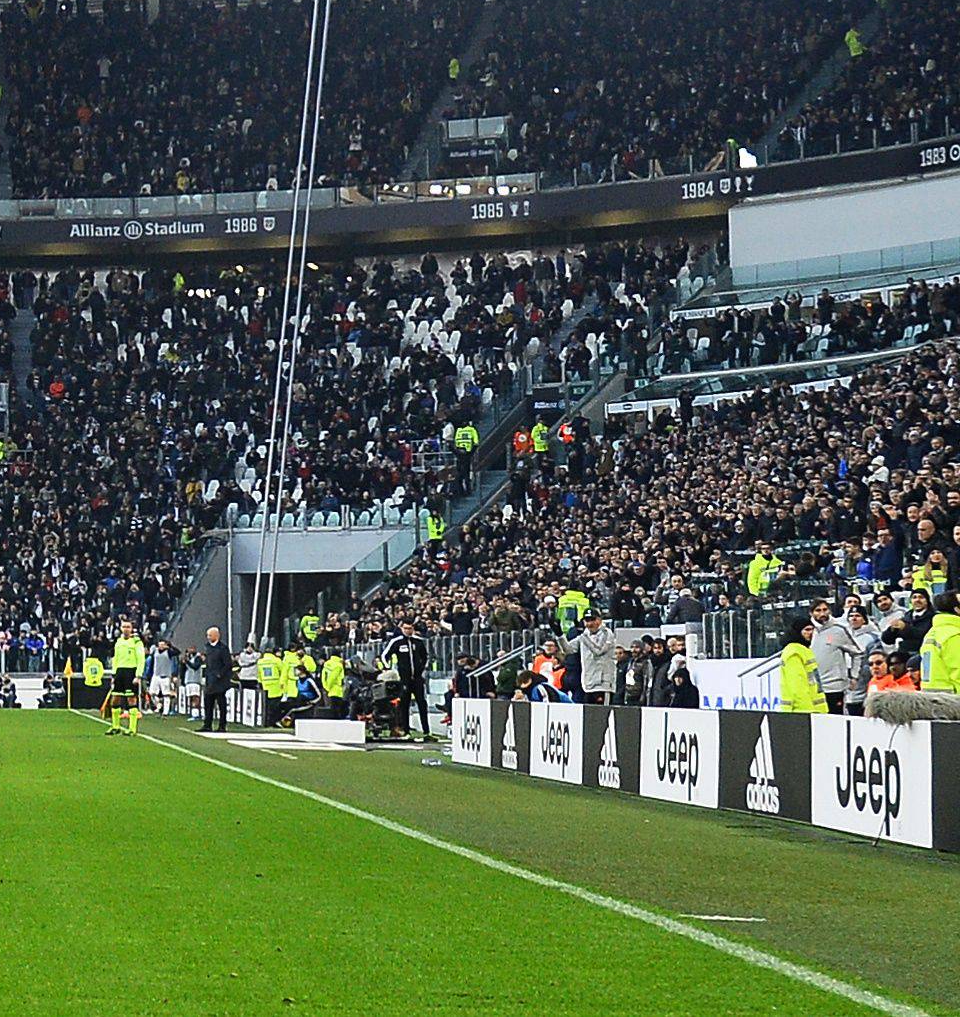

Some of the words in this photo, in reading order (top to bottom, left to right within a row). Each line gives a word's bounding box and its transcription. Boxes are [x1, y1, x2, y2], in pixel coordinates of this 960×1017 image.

[919, 147, 947, 167] 1983
[681, 180, 715, 200] 1984
[224, 218, 258, 233] 1986
[471, 203, 503, 220] 1985
[69, 223, 121, 238] Allianz
[144, 221, 205, 235] Stadium
[460, 700, 482, 763] Jeep
[542, 705, 570, 779] Jeep
[657, 712, 699, 801] Jeep
[598, 760, 620, 789] adidas
[836, 720, 901, 837] Jeep
[746, 778, 780, 814] adidas
